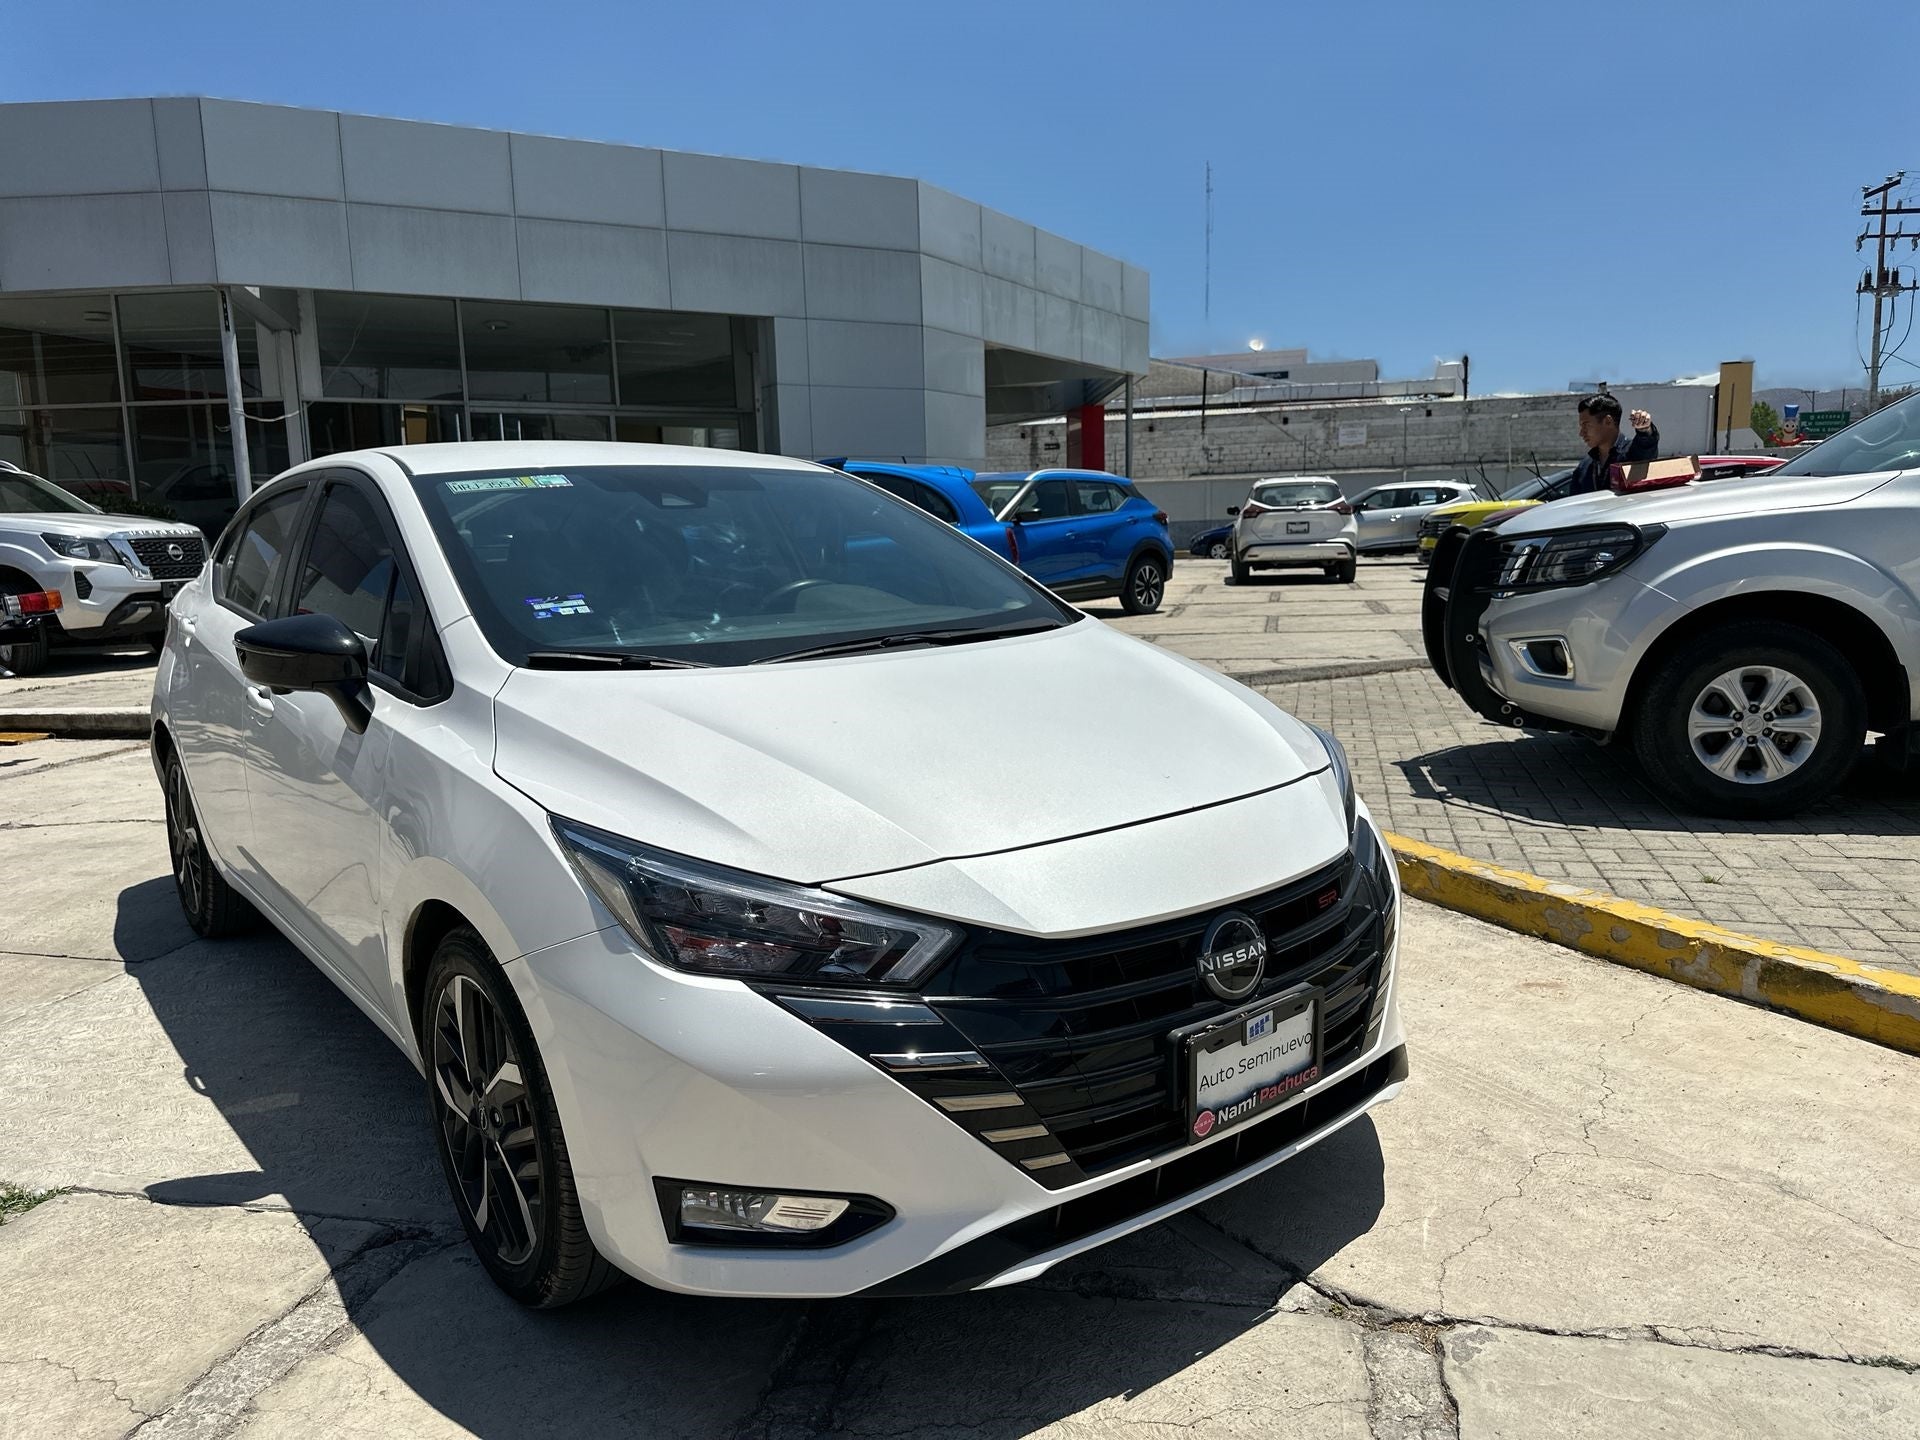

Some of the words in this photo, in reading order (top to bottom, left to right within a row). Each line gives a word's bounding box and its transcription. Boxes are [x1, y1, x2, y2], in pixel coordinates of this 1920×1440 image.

[1319, 889, 1337, 908] SR
[1199, 935, 1267, 974] NISSAN
[1199, 1066, 1235, 1092] Auto
[1238, 1032, 1313, 1074] Seminuevo
[1217, 1092, 1257, 1125] Nami
[1260, 1065, 1318, 1103] Pachuca
